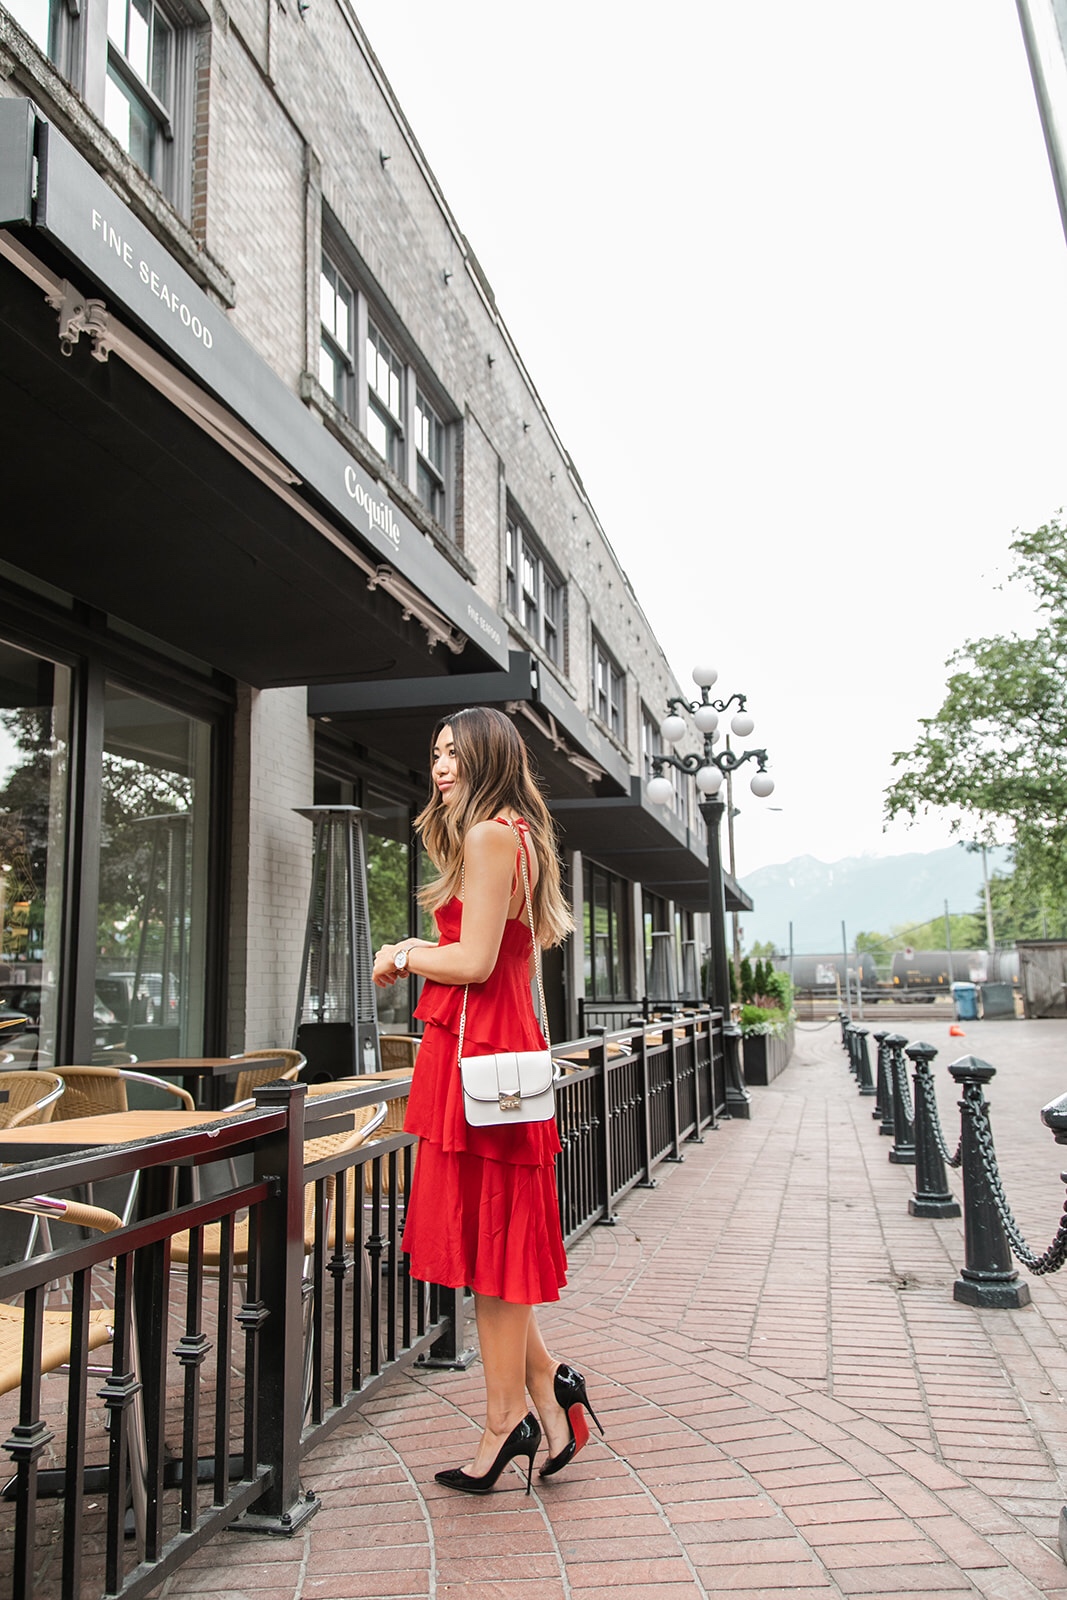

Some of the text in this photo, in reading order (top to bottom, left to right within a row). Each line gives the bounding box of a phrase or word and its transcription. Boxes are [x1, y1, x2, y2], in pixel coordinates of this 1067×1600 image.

[92, 209, 213, 349] FINE SEAFOOD
[344, 465, 401, 551] Coquille
[467, 604, 479, 625] FINE
